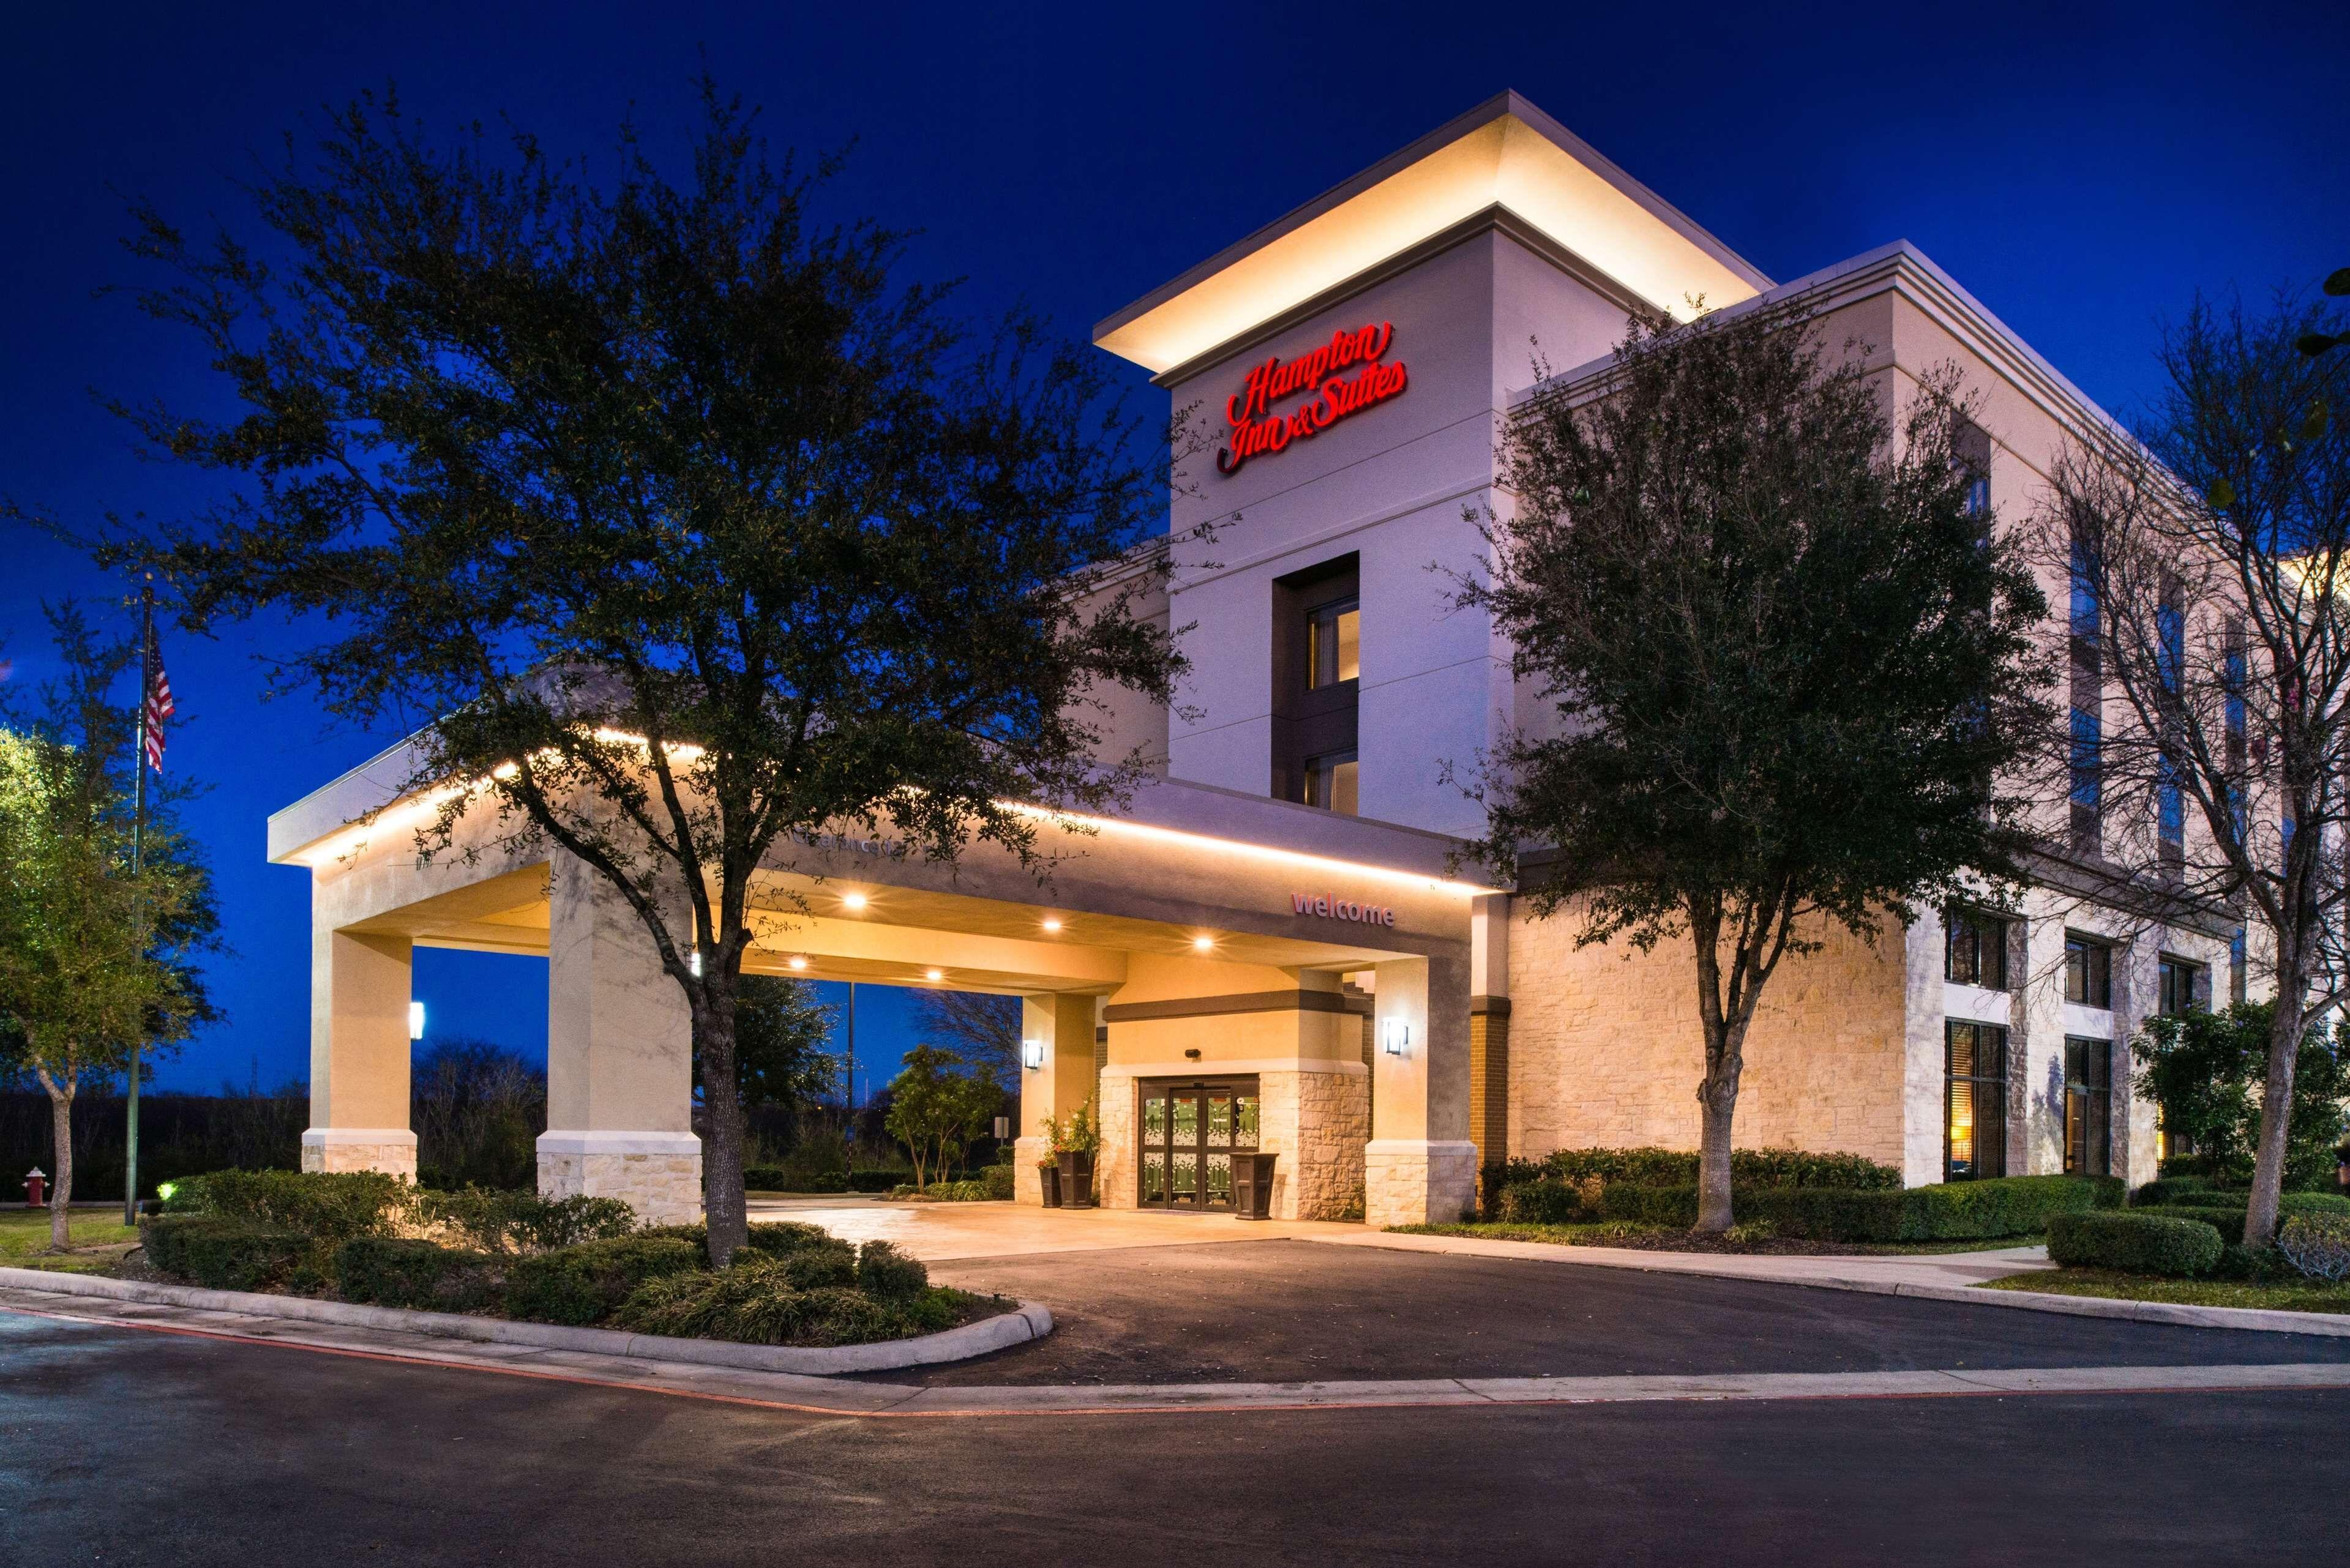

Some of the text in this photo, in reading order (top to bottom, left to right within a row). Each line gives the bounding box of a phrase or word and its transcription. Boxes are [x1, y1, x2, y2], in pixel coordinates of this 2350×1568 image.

[1227, 321, 1394, 427] Hampton
[1217, 360, 1406, 474] Inn & Suites
[793, 826, 879, 855] Clarance
[1292, 892, 1395, 927] welcome
